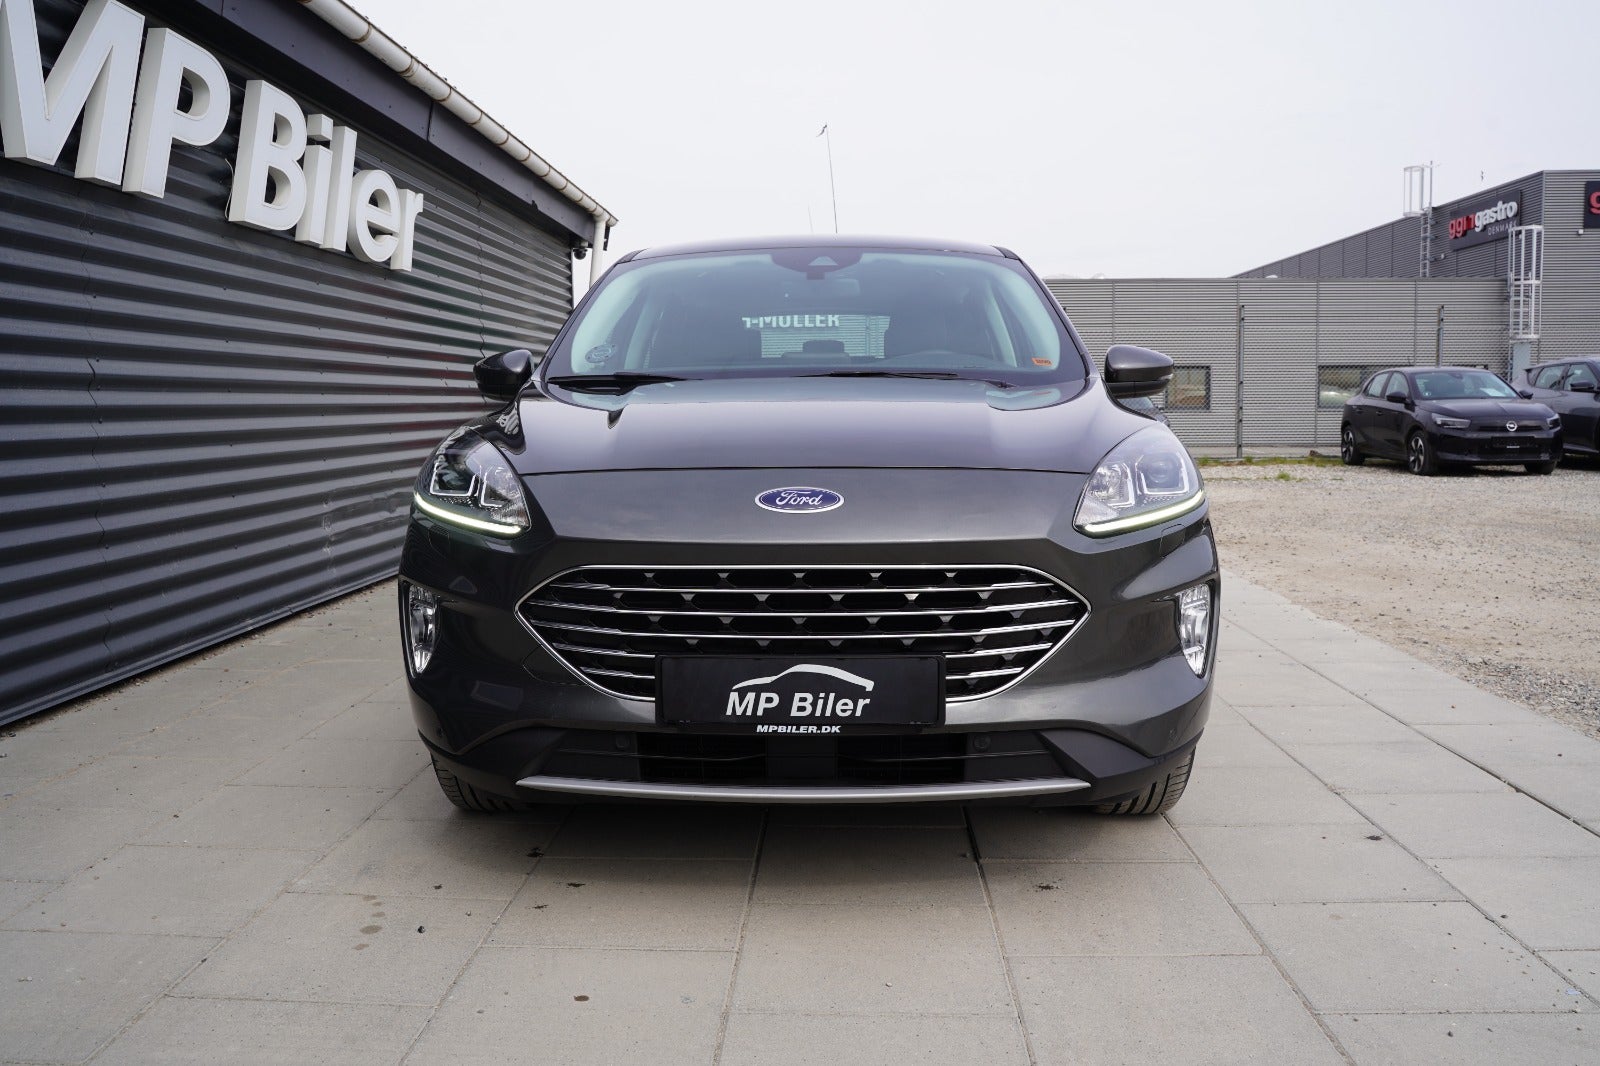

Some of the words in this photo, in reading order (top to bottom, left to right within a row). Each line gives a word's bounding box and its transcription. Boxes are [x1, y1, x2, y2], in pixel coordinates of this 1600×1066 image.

[0, 0, 231, 199] MP
[228, 79, 424, 273] Biler
[775, 490, 823, 505] Ford
[725, 692, 779, 716] MP
[790, 692, 870, 717] Biler
[756, 724, 841, 733] MPBILER.DK
